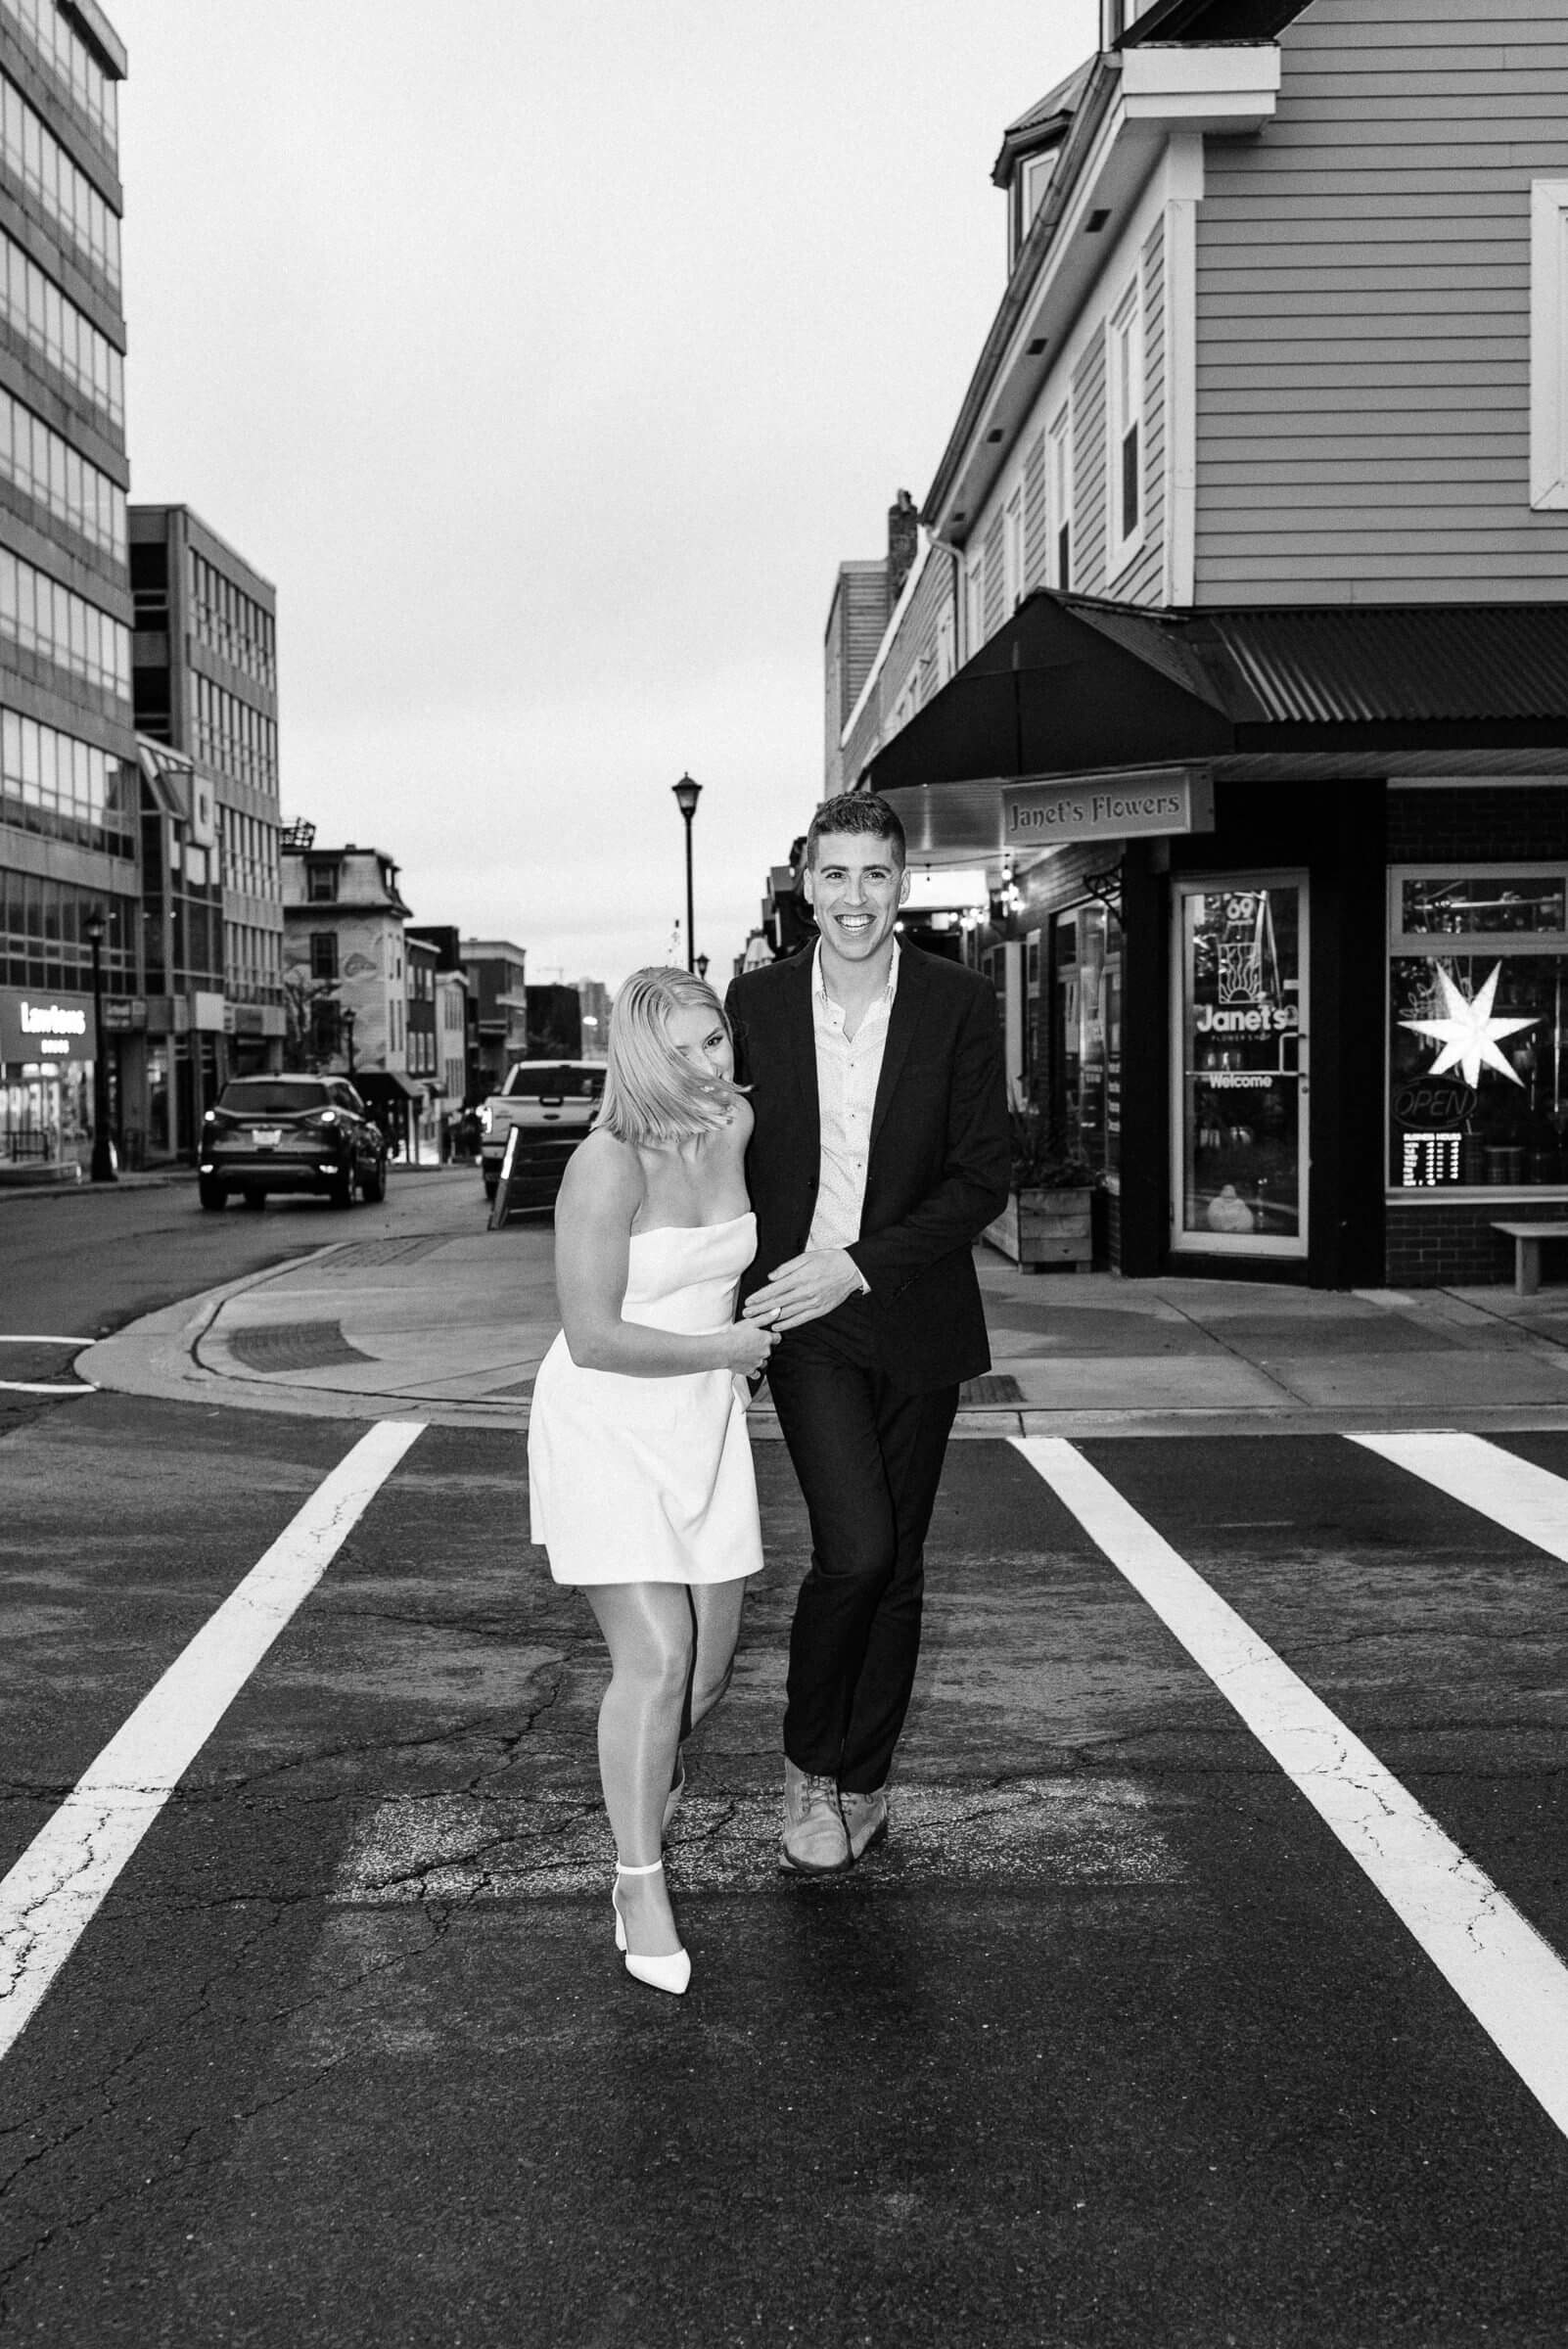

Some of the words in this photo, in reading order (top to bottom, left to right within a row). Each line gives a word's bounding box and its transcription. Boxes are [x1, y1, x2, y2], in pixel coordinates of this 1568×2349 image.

[1011, 799, 1084, 832] Janet's
[1092, 794, 1180, 823] Flowers
[1226, 898, 1254, 919] 69
[1196, 1003, 1287, 1033] Janet's
[1210, 1072, 1272, 1088] Welcome
[1396, 1089, 1468, 1116] OPEN
